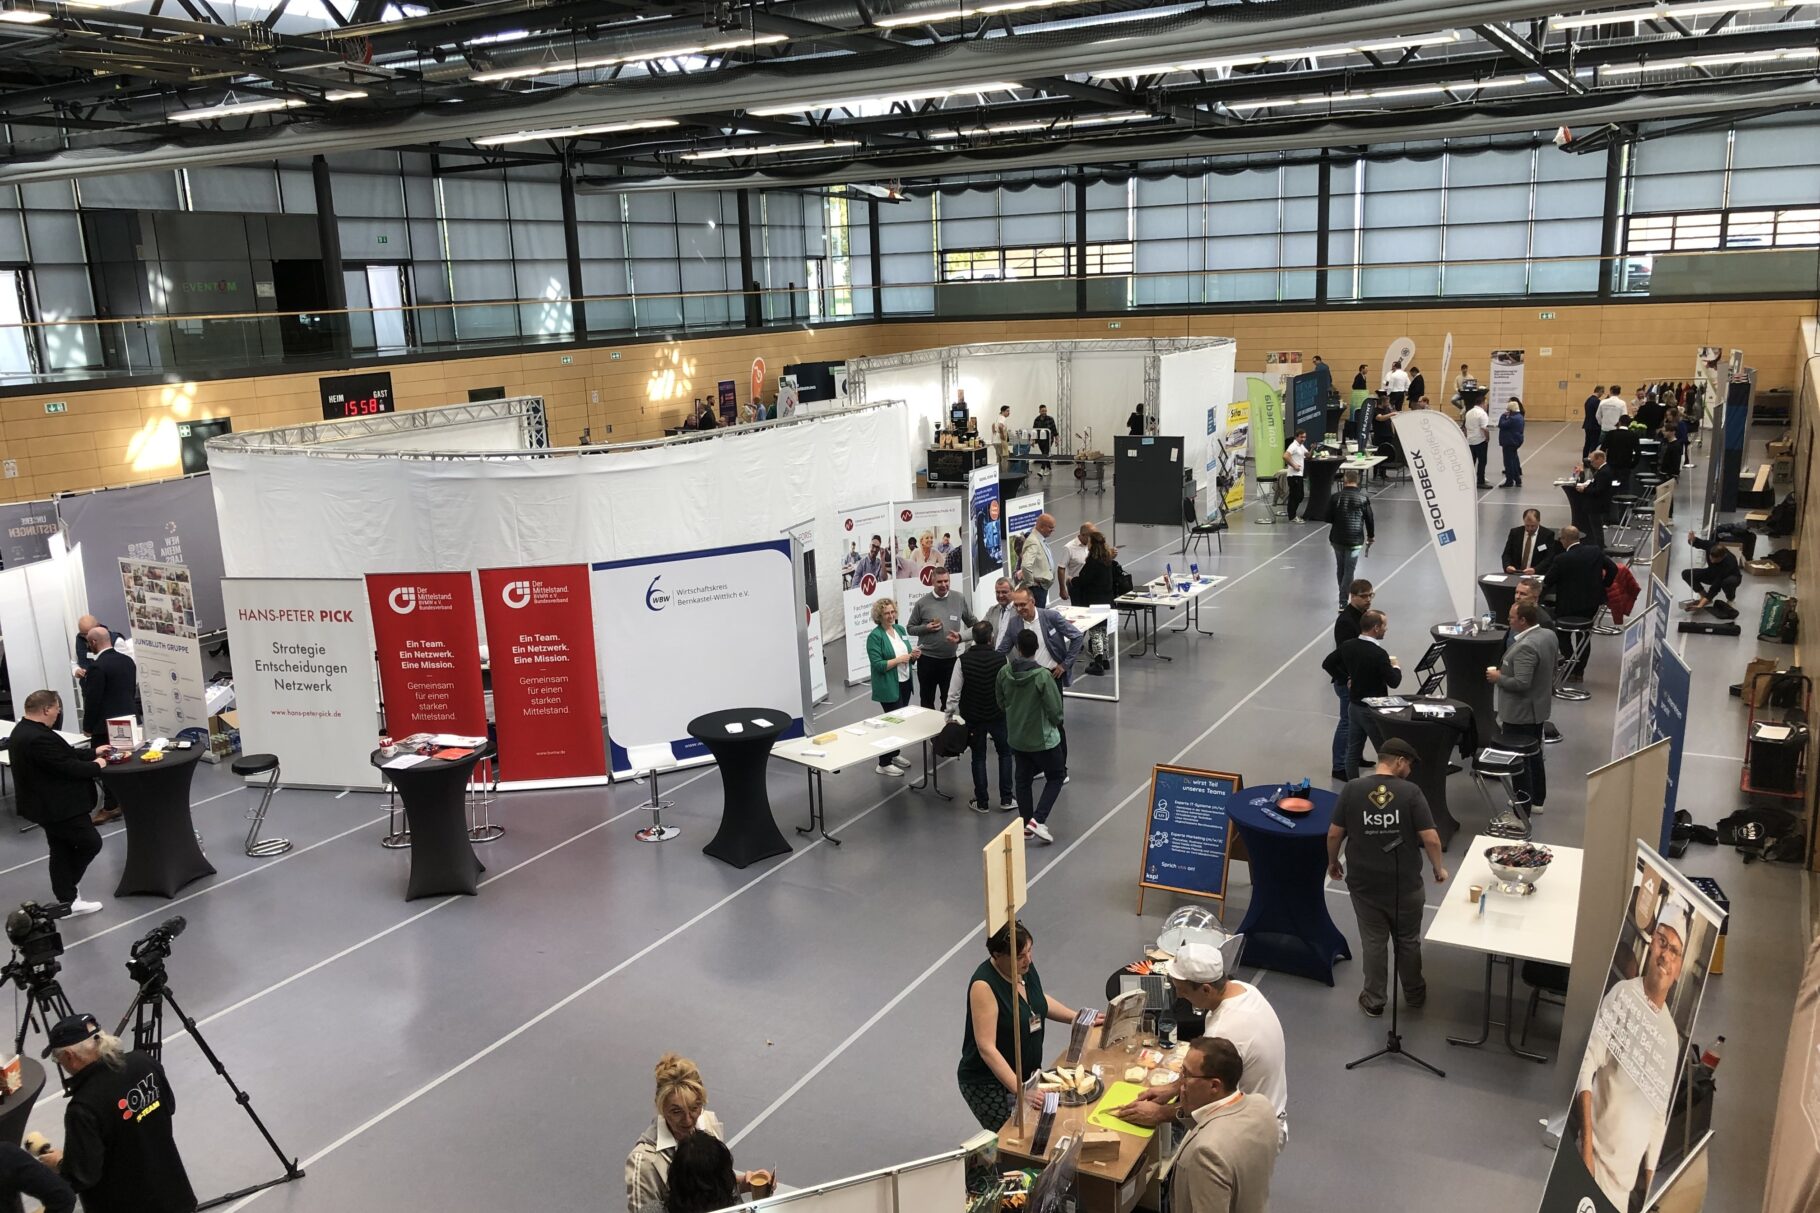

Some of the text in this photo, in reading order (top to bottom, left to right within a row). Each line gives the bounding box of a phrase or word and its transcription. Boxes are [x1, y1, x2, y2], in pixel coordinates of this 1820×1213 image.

[329, 394, 344, 403] HEIM
[373, 390, 388, 399] GAST
[677, 584, 728, 596] Wirtschaftskreis
[652, 595, 671, 604] WBW
[678, 590, 750, 606] Bernkastel-Wittlich e.V.
[238, 609, 354, 623] HANS-PETER PICK
[519, 634, 560, 643] Ein Team.
[167, 642, 190, 654] GRUPPE
[406, 640, 446, 649] Ein Team.
[512, 644, 570, 654] Ein Netzwerk.
[272, 642, 326, 658] Strategie
[400, 650, 455, 659] Ein Netzwerk.
[514, 654, 570, 665] Eine Mission.
[255, 660, 348, 676] Entscheidungen
[401, 661, 455, 670] Eine Mission.
[519, 675, 569, 685] Gemeinsam
[274, 679, 333, 692] Netzwerk
[407, 682, 455, 691] Gemeinsam
[528, 686, 563, 695] für einen
[415, 692, 449, 700] für einen
[531, 697, 562, 705] starken
[419, 702, 448, 711] starken
[271, 709, 342, 719] www.hans-peter-pick.de
[1207, 788, 1226, 796] Teams
[1363, 810, 1400, 829] kspl
[1161, 861, 1177, 869] Sprich
